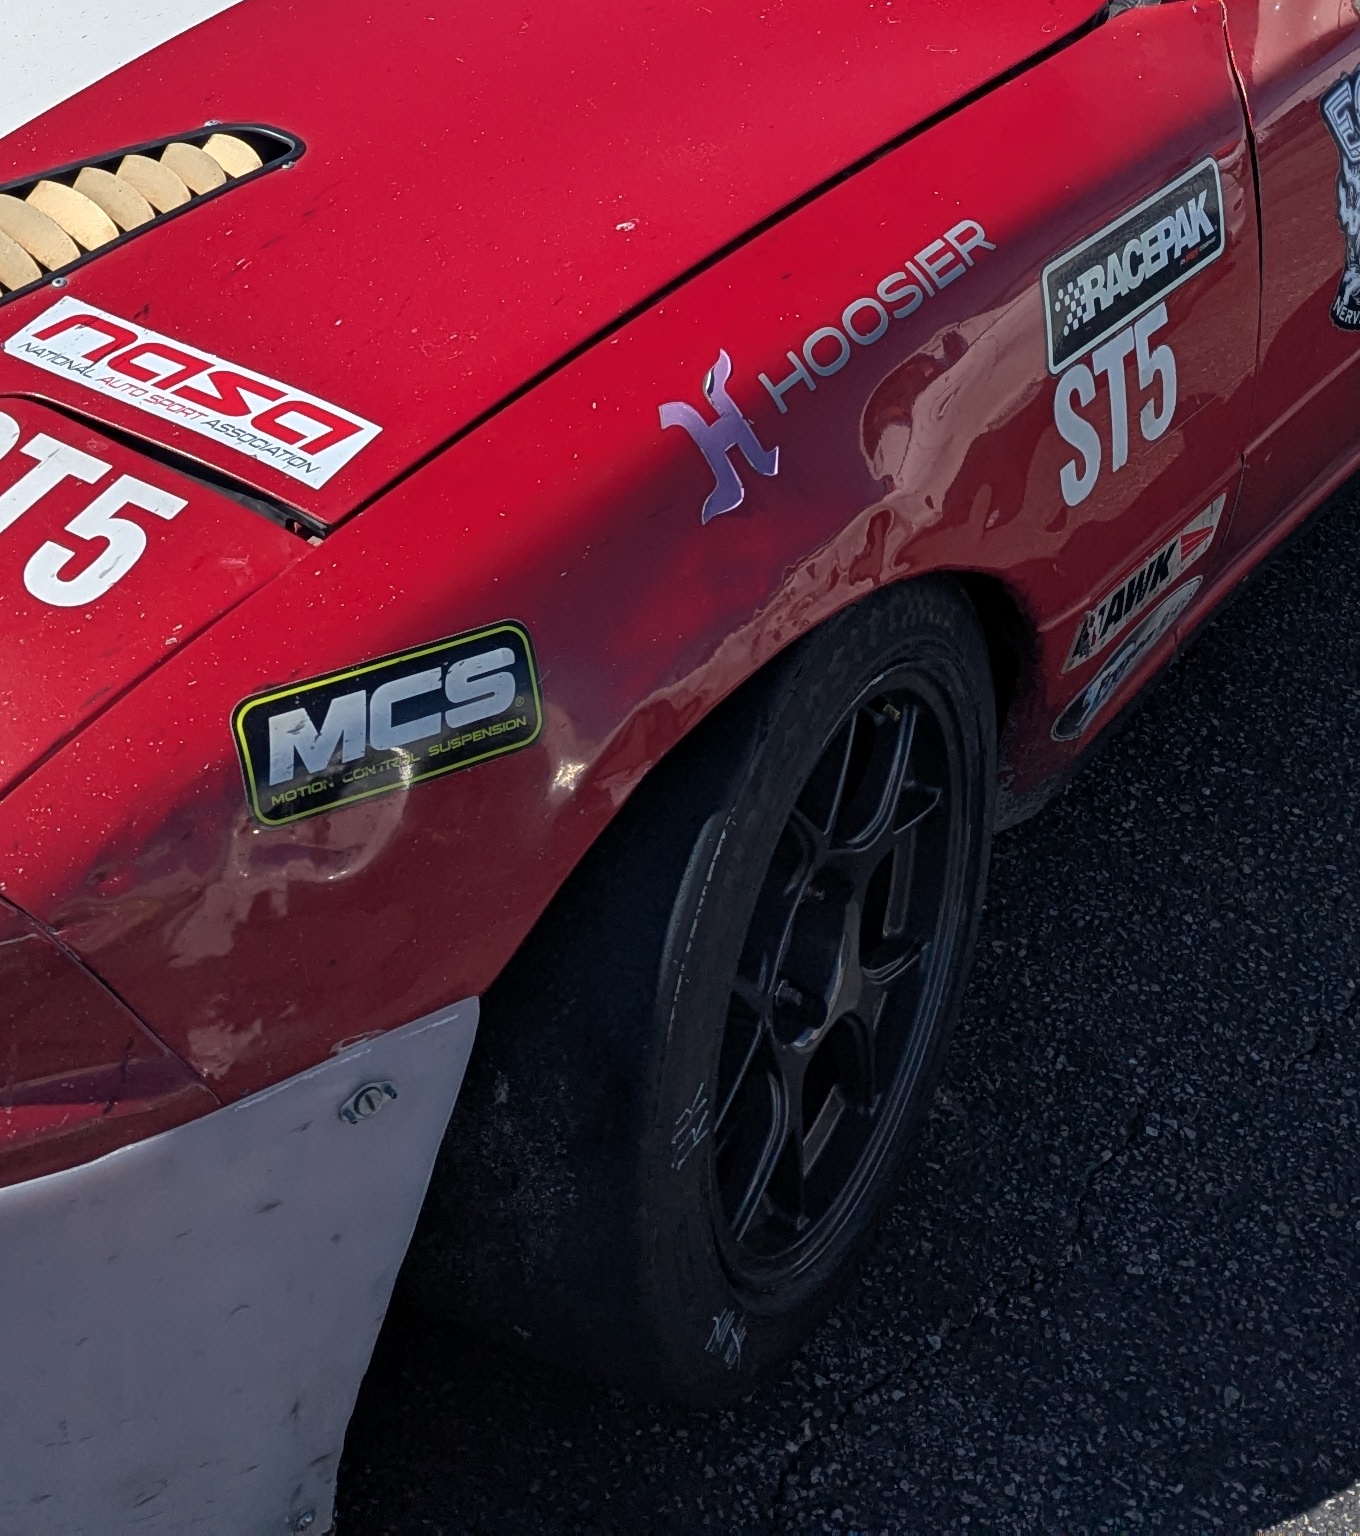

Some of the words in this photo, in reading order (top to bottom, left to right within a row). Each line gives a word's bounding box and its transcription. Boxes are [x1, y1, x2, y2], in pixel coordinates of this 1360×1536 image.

[757, 218, 997, 415] HOOSIER
[1077, 188, 1215, 324] RACEPAK
[17, 341, 96, 379] NATIONAL
[98, 374, 150, 399] AUTO
[147, 391, 210, 421] SPORT
[201, 417, 322, 476] ASSOCIATION
[31, 313, 365, 456] nasa
[1053, 300, 1178, 507] ST5
[268, 646, 517, 786] MCS
[271, 778, 335, 807] MOTION
[341, 752, 422, 785] CONTROL
[427, 715, 527, 758] SUSPENSION
